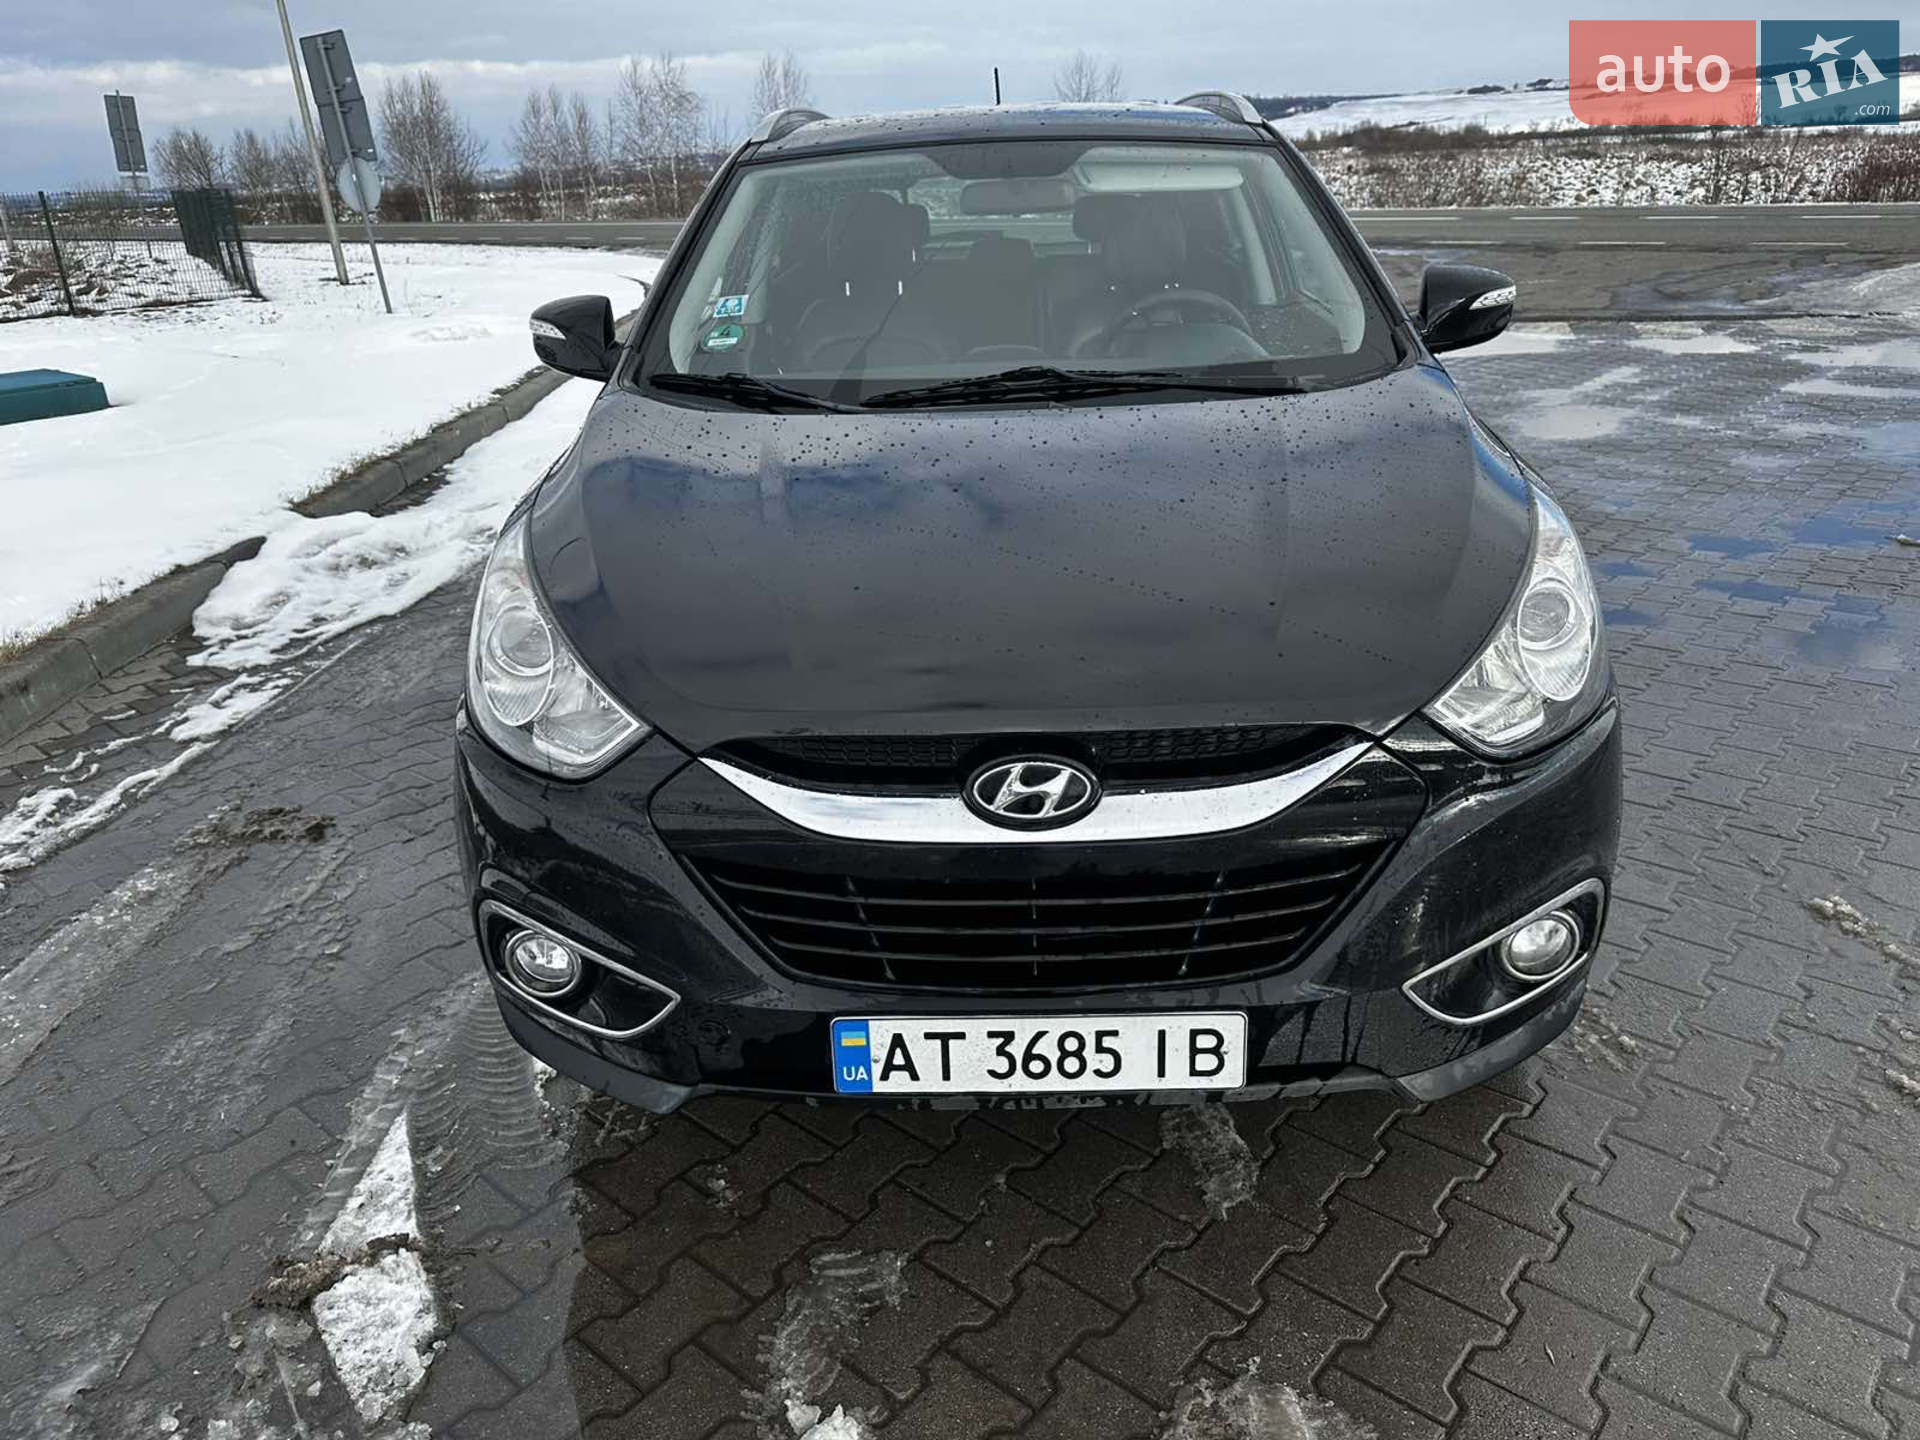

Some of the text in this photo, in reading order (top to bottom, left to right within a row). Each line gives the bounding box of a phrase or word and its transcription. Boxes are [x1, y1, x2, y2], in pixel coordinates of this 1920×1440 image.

[879, 1028, 1226, 1082] AT 3685 IB
[843, 1066, 868, 1081] UA
